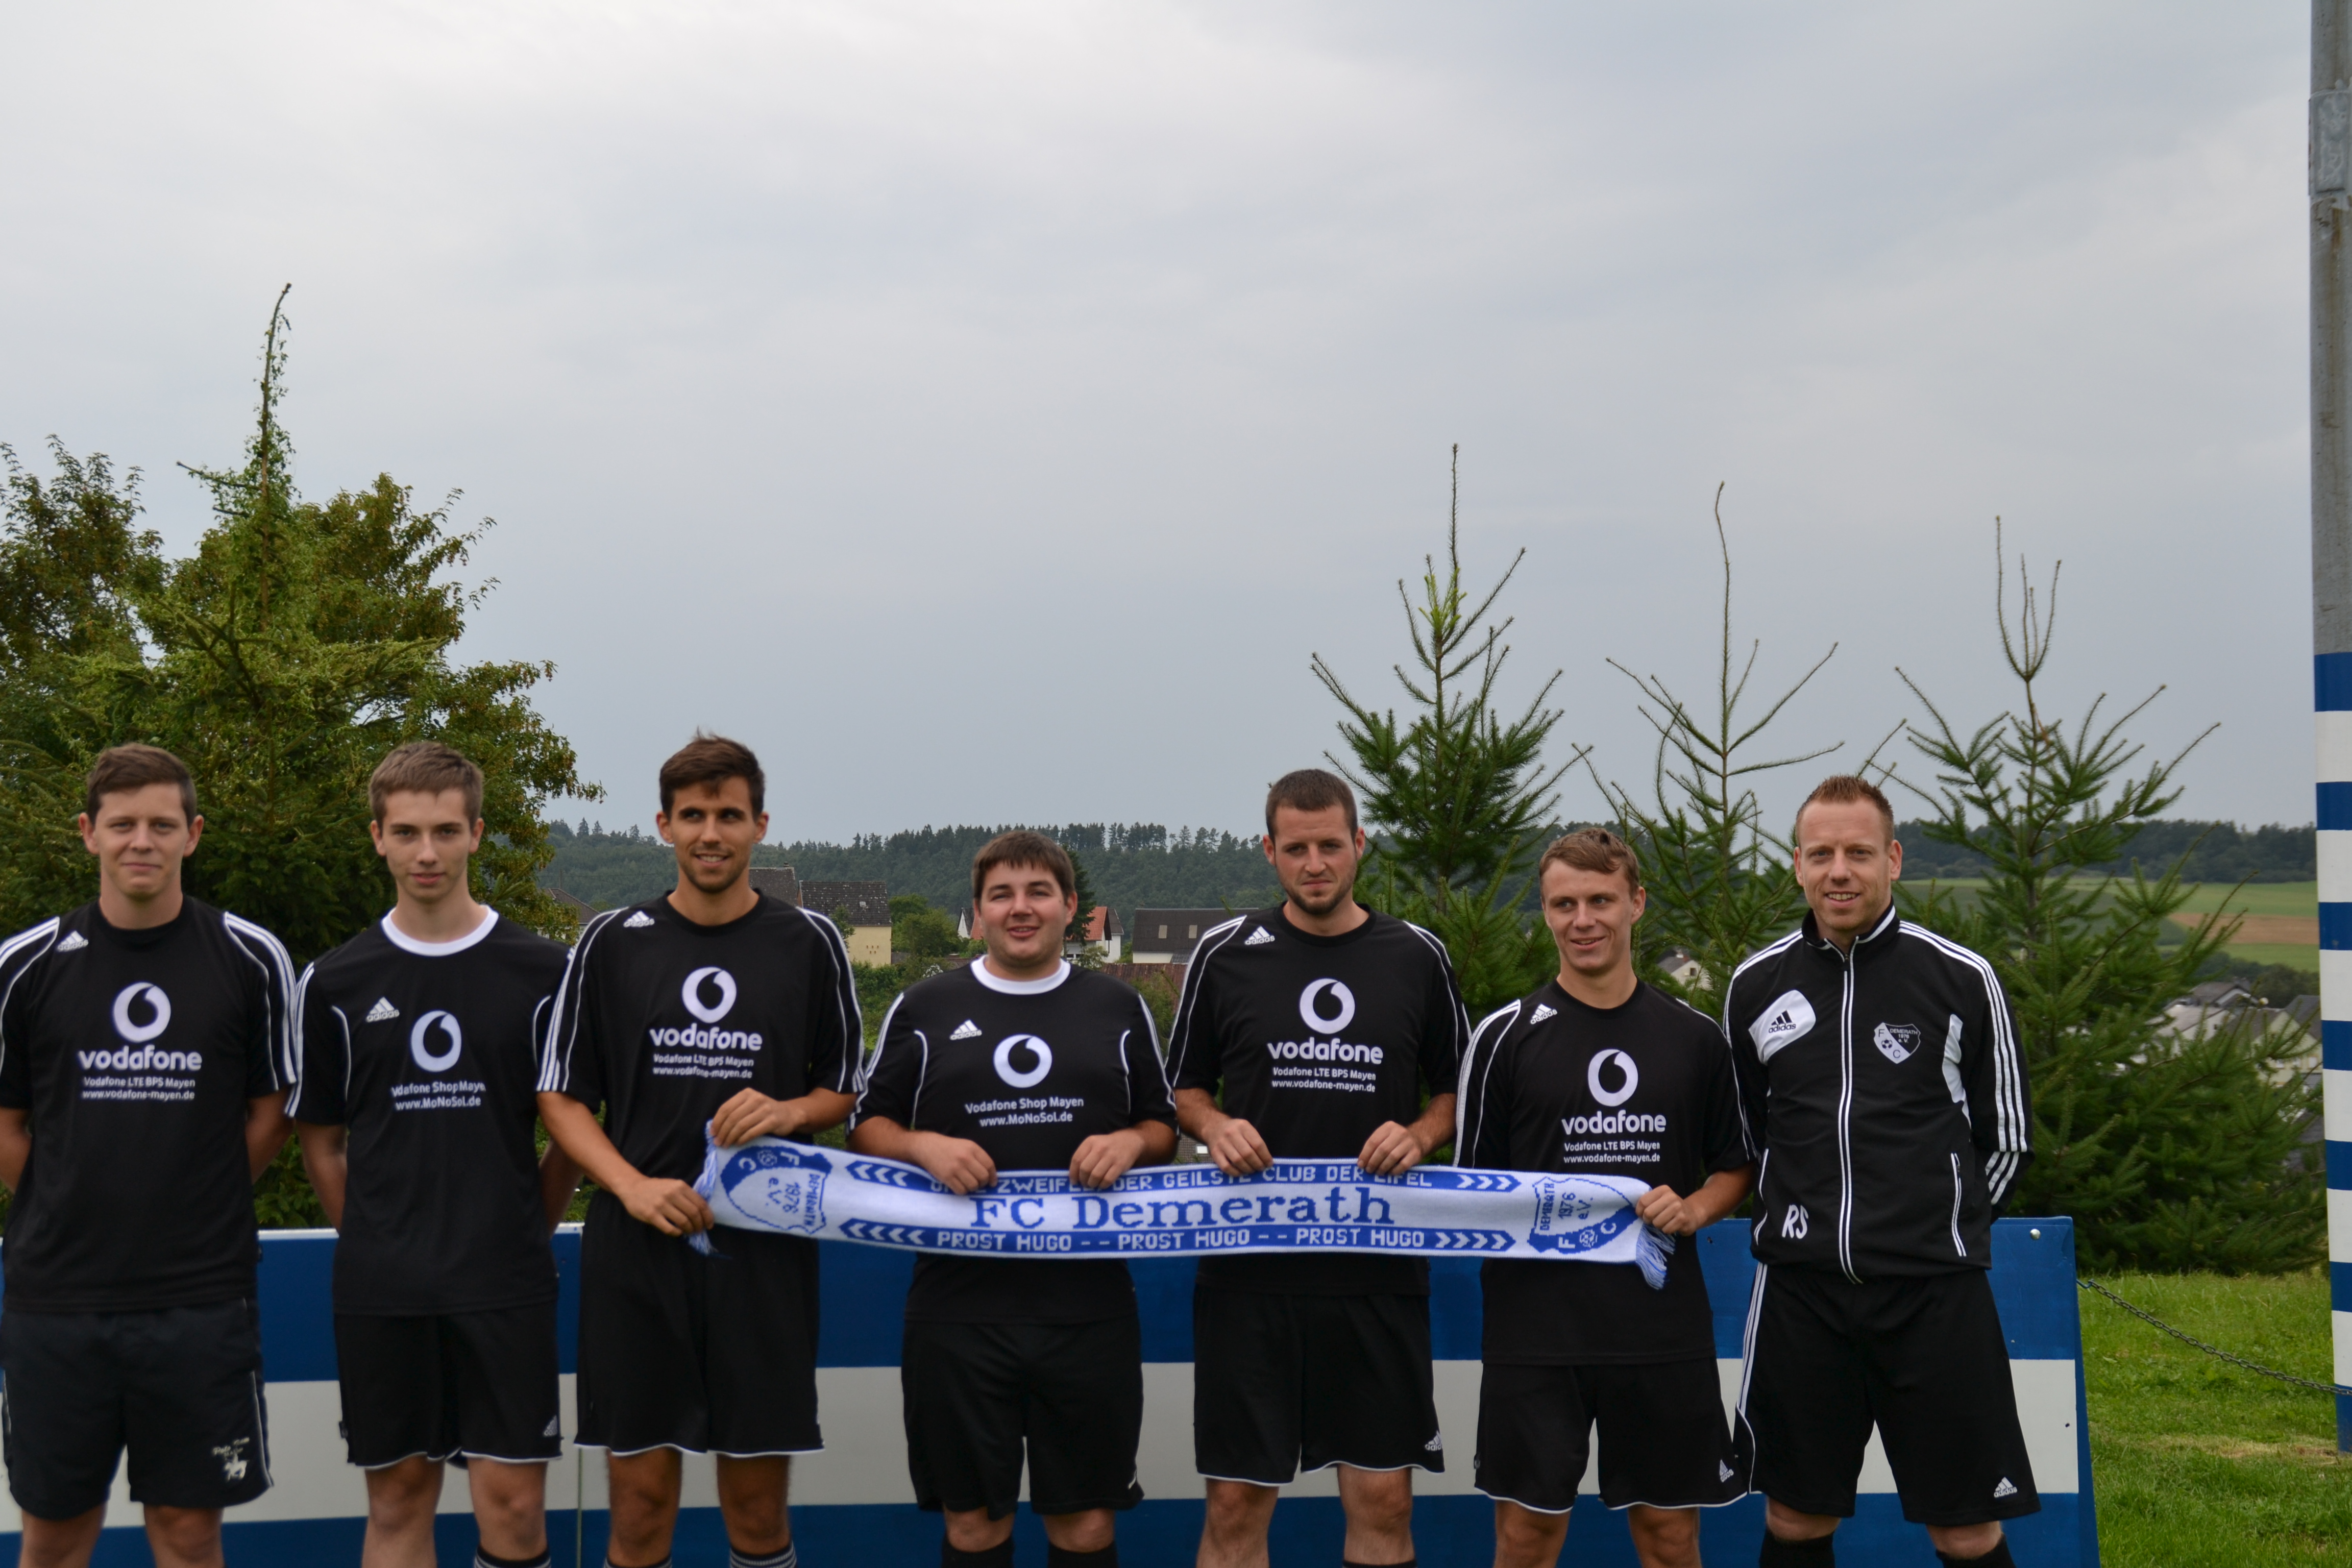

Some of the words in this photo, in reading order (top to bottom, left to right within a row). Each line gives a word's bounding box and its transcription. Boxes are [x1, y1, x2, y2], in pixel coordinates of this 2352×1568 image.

[623, 918, 655, 928] adidas
[57, 939, 88, 952] adidas
[1244, 935, 1275, 945] adidas
[366, 1009, 400, 1023] adidas
[1530, 1009, 1558, 1024] adidas
[949, 1030, 982, 1041] adidas
[1769, 1023, 1797, 1034] adidas
[1878, 1028, 1885, 1038] F
[650, 1022, 763, 1051] vodafone
[78, 1044, 203, 1071] vodafone
[1267, 1037, 1384, 1065] vodafone
[1893, 1049, 1900, 1059] C
[693, 1054, 707, 1066] LTE
[708, 1056, 724, 1067] BPS
[725, 1056, 754, 1068] Mayen
[653, 1065, 752, 1080] www.vodafone-mayen.de
[1273, 1067, 1312, 1076] Vodafone
[1314, 1068, 1330, 1077] LTE
[1332, 1068, 1349, 1078] BPS
[1350, 1070, 1376, 1081] Mayen
[84, 1076, 126, 1088] Vodafone
[128, 1077, 144, 1088] LTE
[145, 1076, 163, 1088] BPS
[165, 1077, 195, 1089] Mayen
[432, 1081, 458, 1094] Shop
[459, 1080, 486, 1093] Maye
[1272, 1079, 1376, 1093] www.vodafone-mayen.de
[82, 1089, 195, 1102] www.vodafone-mayen.de
[396, 1095, 481, 1110] www.MoNoSol.de
[965, 1099, 1018, 1114] Vodafone
[1019, 1098, 1048, 1111] Shop
[1049, 1096, 1084, 1109] Mayen
[979, 1112, 1073, 1127] www.MoNoSol.de
[1561, 1110, 1667, 1135] vodafone
[1564, 1141, 1602, 1152] Vodafone
[1603, 1141, 1618, 1151] LTE
[1620, 1141, 1635, 1150] BPS
[1637, 1140, 1660, 1151] Mayen
[739, 1157, 756, 1171] C
[780, 1151, 800, 1166] F
[1563, 1153, 1660, 1164] www.vodafone-mayen.de
[1113, 1175, 1152, 1191] DER
[1262, 1166, 1316, 1182] CLUB
[1327, 1165, 1364, 1182] DER
[970, 1197, 1045, 1229] FC
[1072, 1186, 1395, 1229] Demerath
[1540, 1183, 1555, 1231] DEMERATH
[1558, 1192, 1576, 1219] 1976
[1601, 1222, 1617, 1234] C
[1781, 1204, 1809, 1239] RS
[937, 1231, 1006, 1251] PROST
[1017, 1234, 1071, 1252] HUGO
[1118, 1232, 1185, 1250] PROST
[1195, 1229, 1250, 1247] HUGO
[1296, 1228, 1361, 1245] PROST
[1371, 1229, 1425, 1247] HUGO
[1558, 1236, 1576, 1248] F
[1994, 1486, 2018, 1498] adidas
